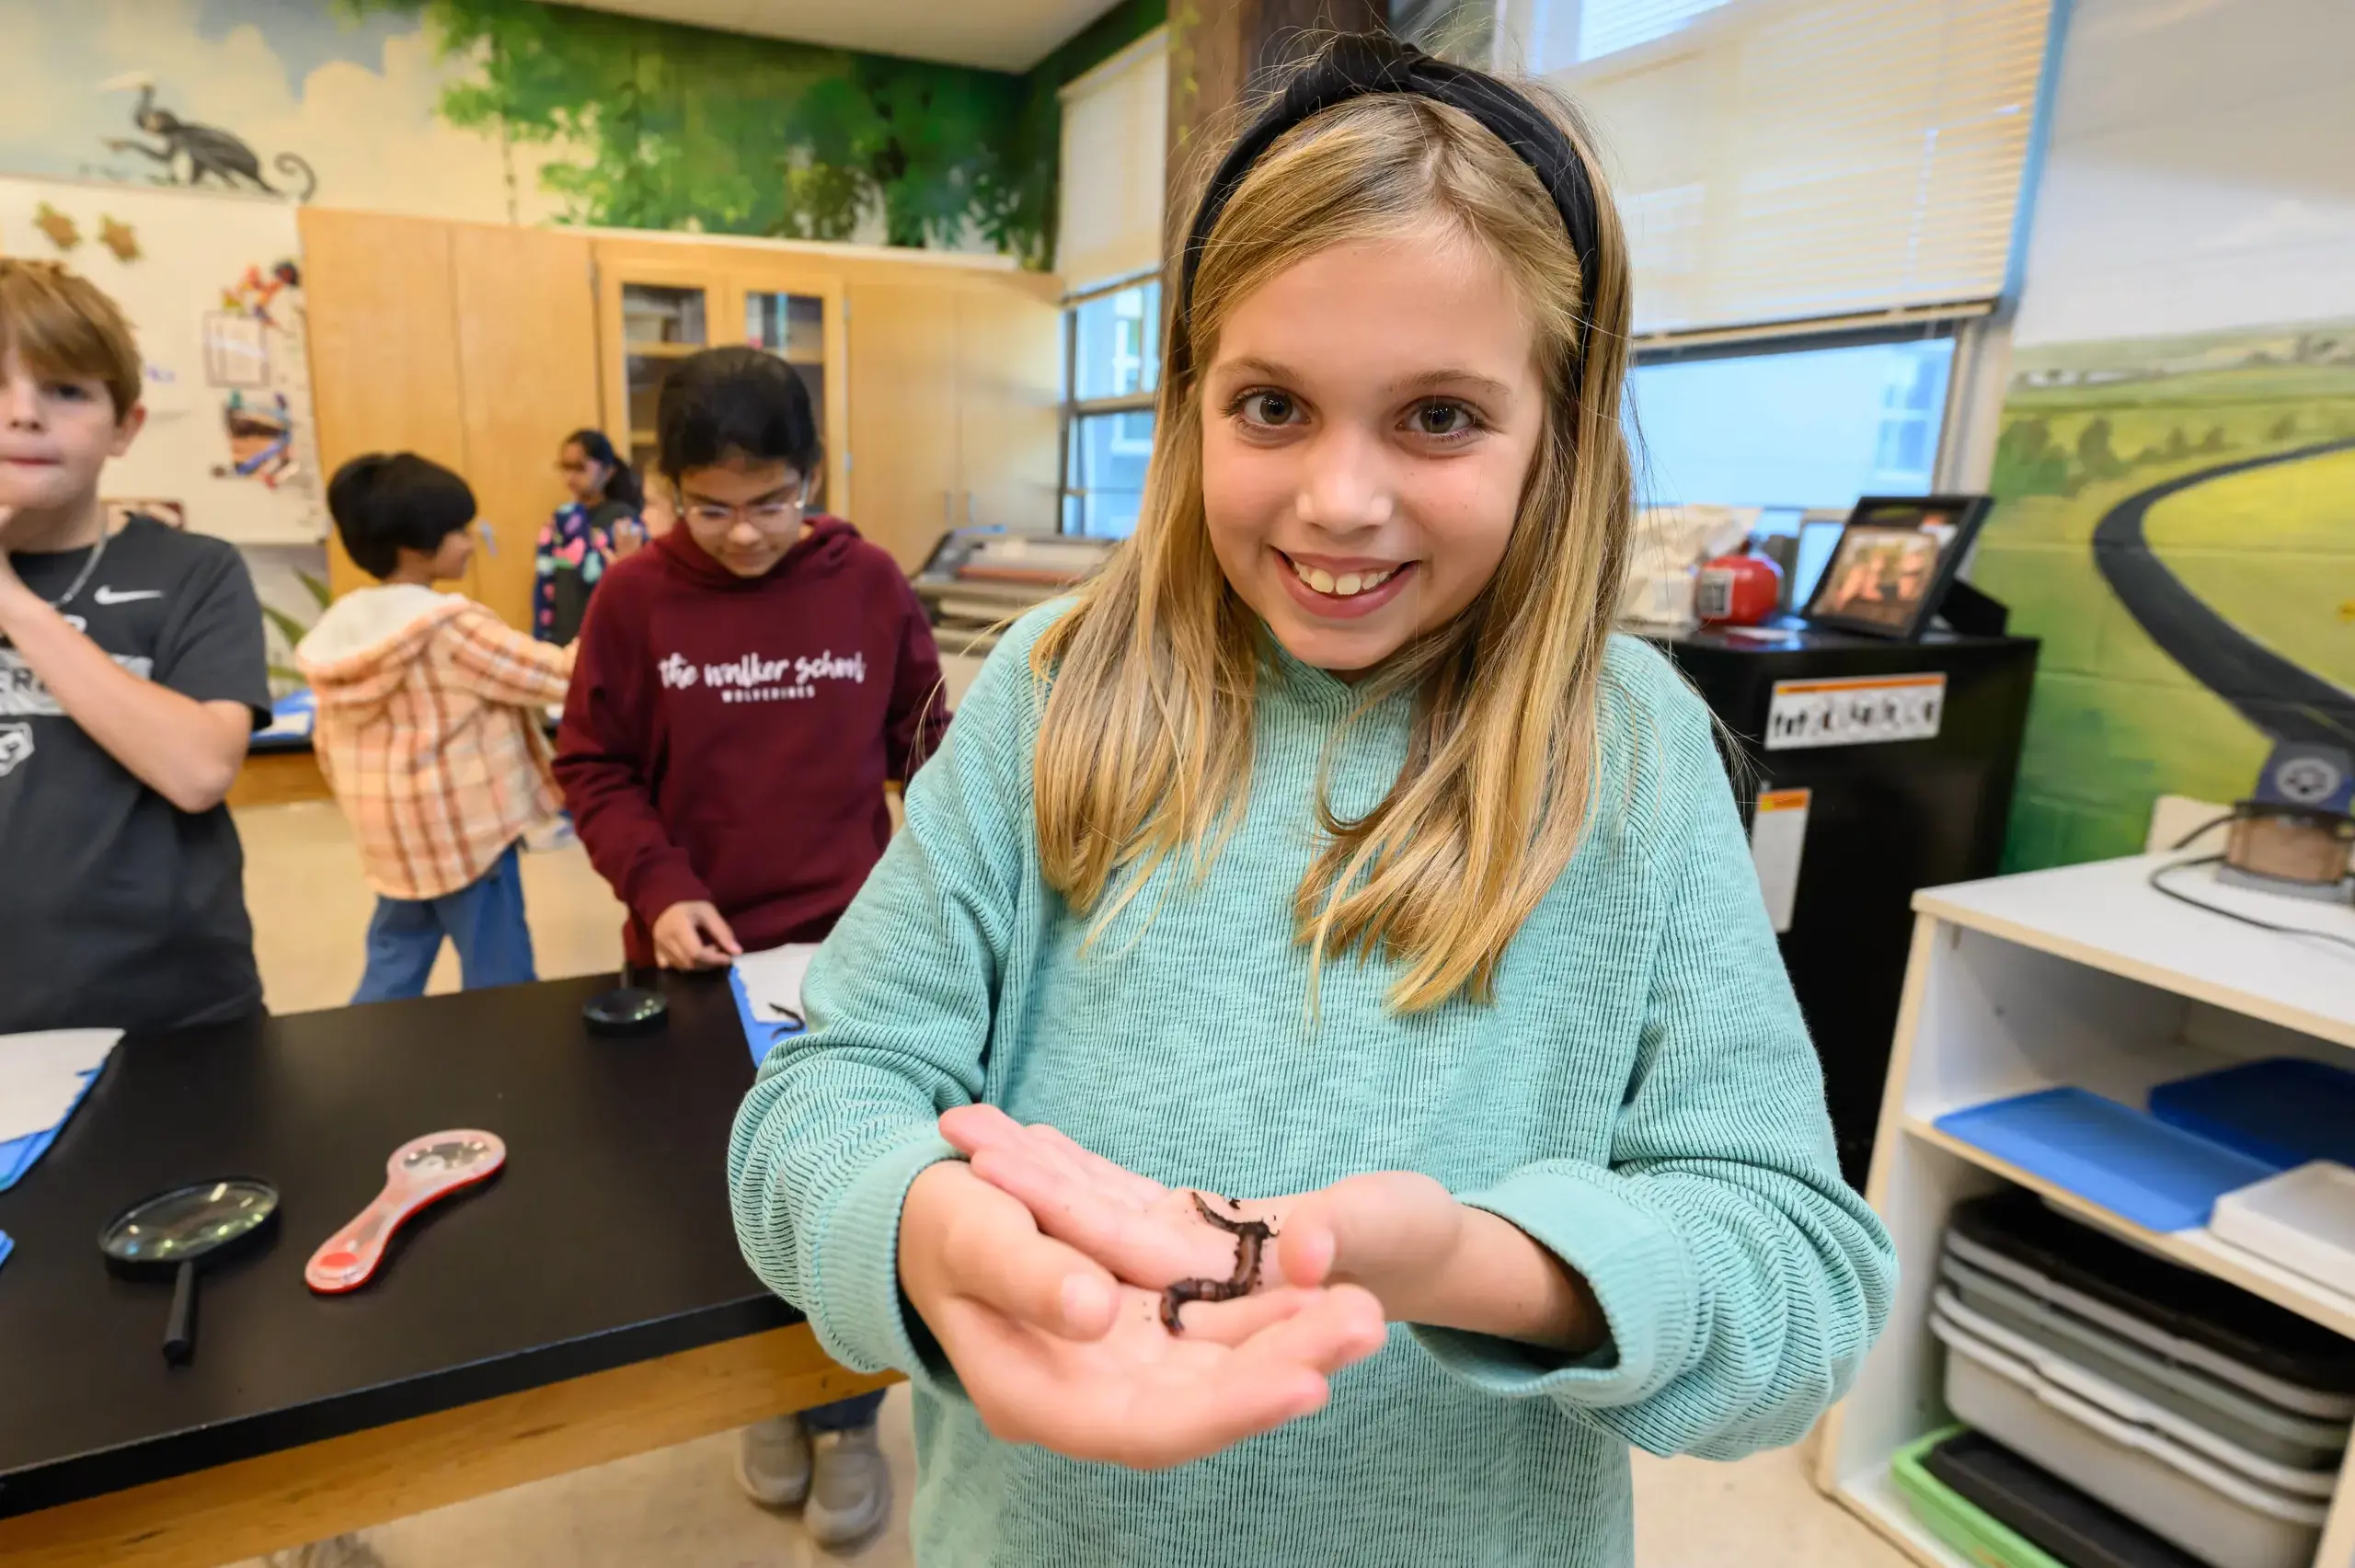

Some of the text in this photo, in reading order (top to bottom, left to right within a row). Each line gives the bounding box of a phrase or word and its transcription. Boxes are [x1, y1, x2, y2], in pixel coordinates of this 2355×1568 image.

[658, 649, 867, 689] the walker school
